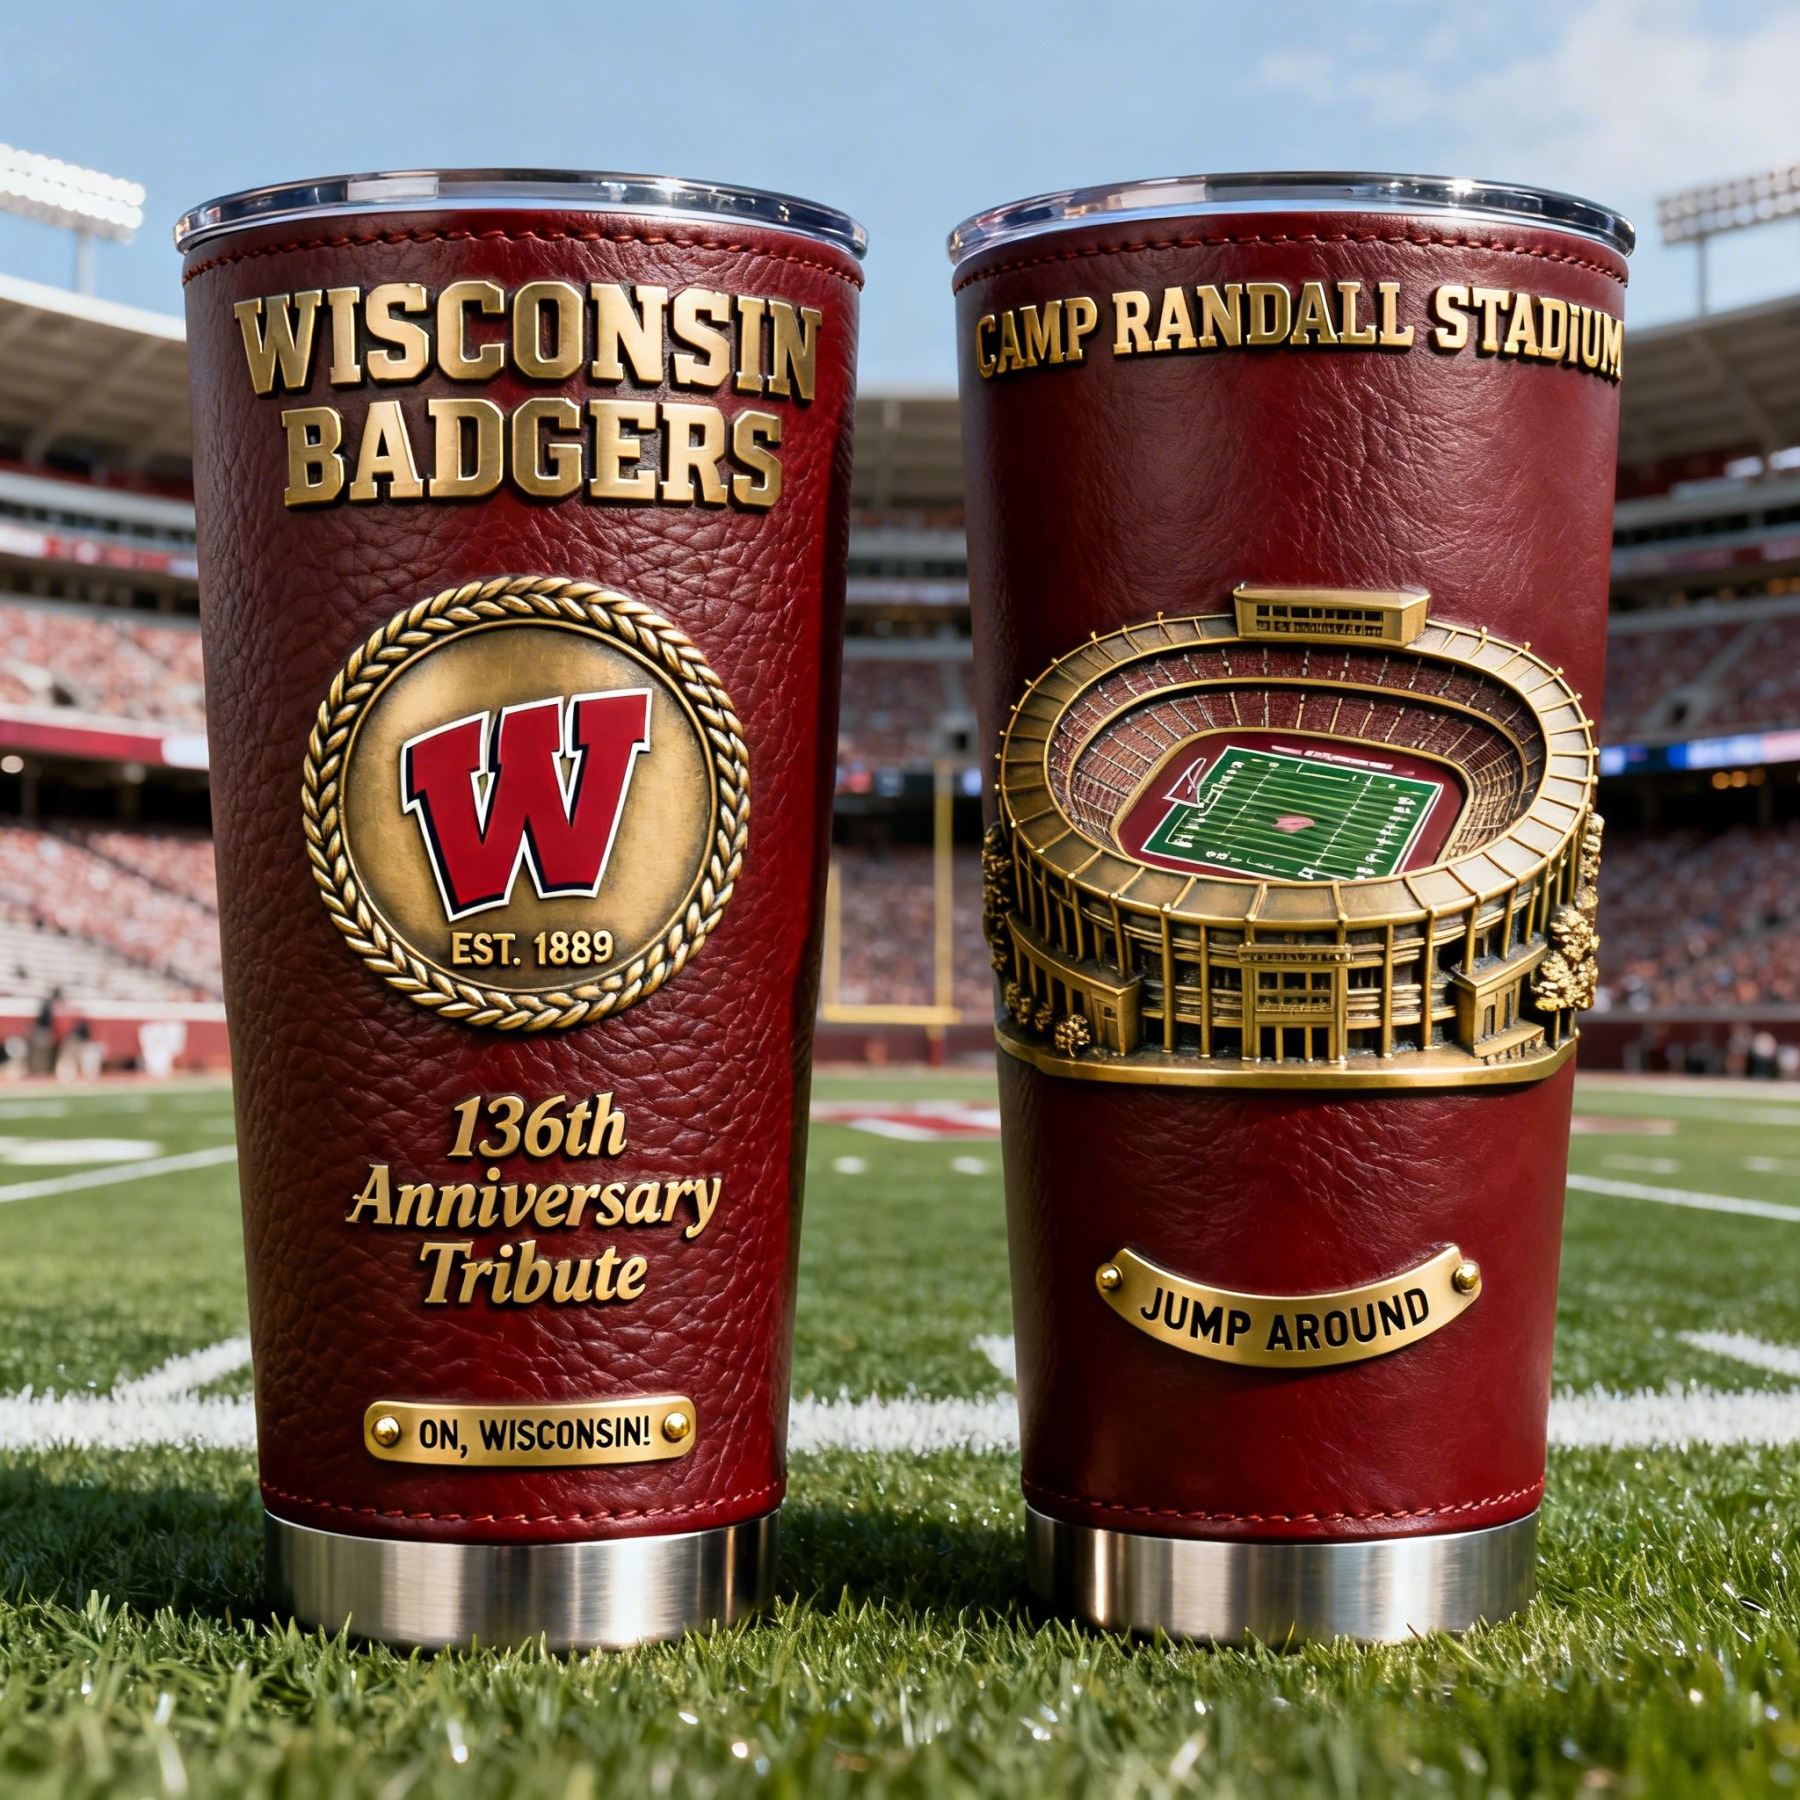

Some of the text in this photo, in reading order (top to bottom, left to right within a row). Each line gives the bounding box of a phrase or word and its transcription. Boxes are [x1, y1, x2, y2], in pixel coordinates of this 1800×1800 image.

[233, 280, 822, 398] WISCONSIN
[976, 296, 1098, 378] CAMP
[1112, 282, 1414, 352] RANDALL
[282, 397, 783, 506] BADGERS
[401, 688, 652, 922] W
[453, 931, 614, 965] EST. 1889
[447, 1092, 627, 1158] 136th
[345, 1164, 722, 1239] Anniversary
[420, 1240, 647, 1304] Tribute
[1141, 1286, 1429, 1351] JUMP AROUND
[419, 1415, 651, 1458] ON, WISCONSIN!
